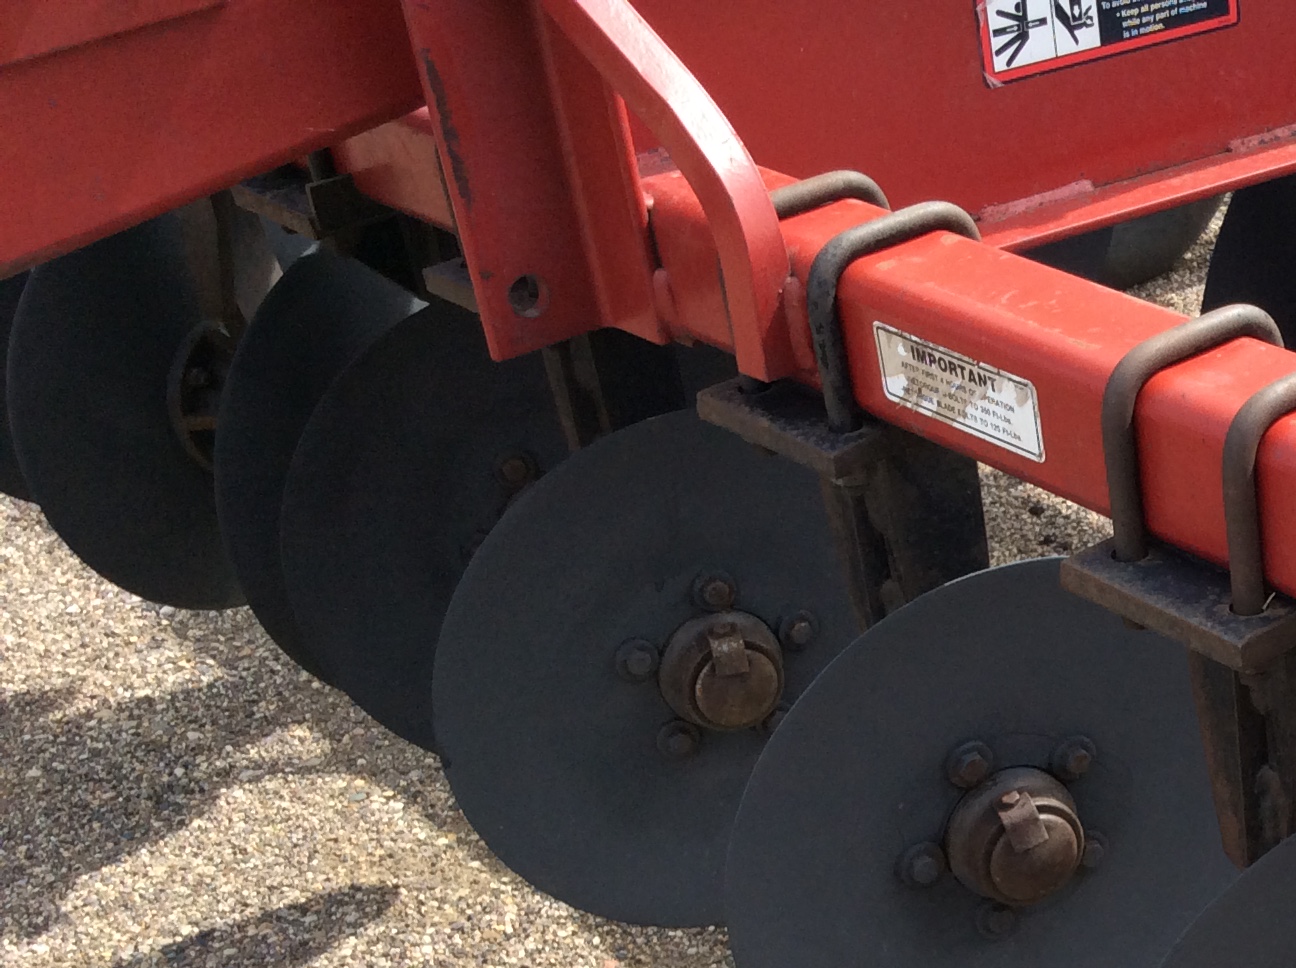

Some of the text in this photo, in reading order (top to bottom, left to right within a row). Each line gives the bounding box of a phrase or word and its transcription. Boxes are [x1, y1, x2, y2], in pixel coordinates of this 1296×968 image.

[1101, 1, 1111, 10] To
[1121, 0, 1178, 18] Keep all persons
[1122, 1, 1208, 28] while any part of machine
[1122, 22, 1165, 39] is in motion.
[910, 345, 997, 393] IMPORTANT
[921, 369, 939, 381] FIRST
[969, 400, 979, 412] TO
[979, 417, 989, 428] TO
